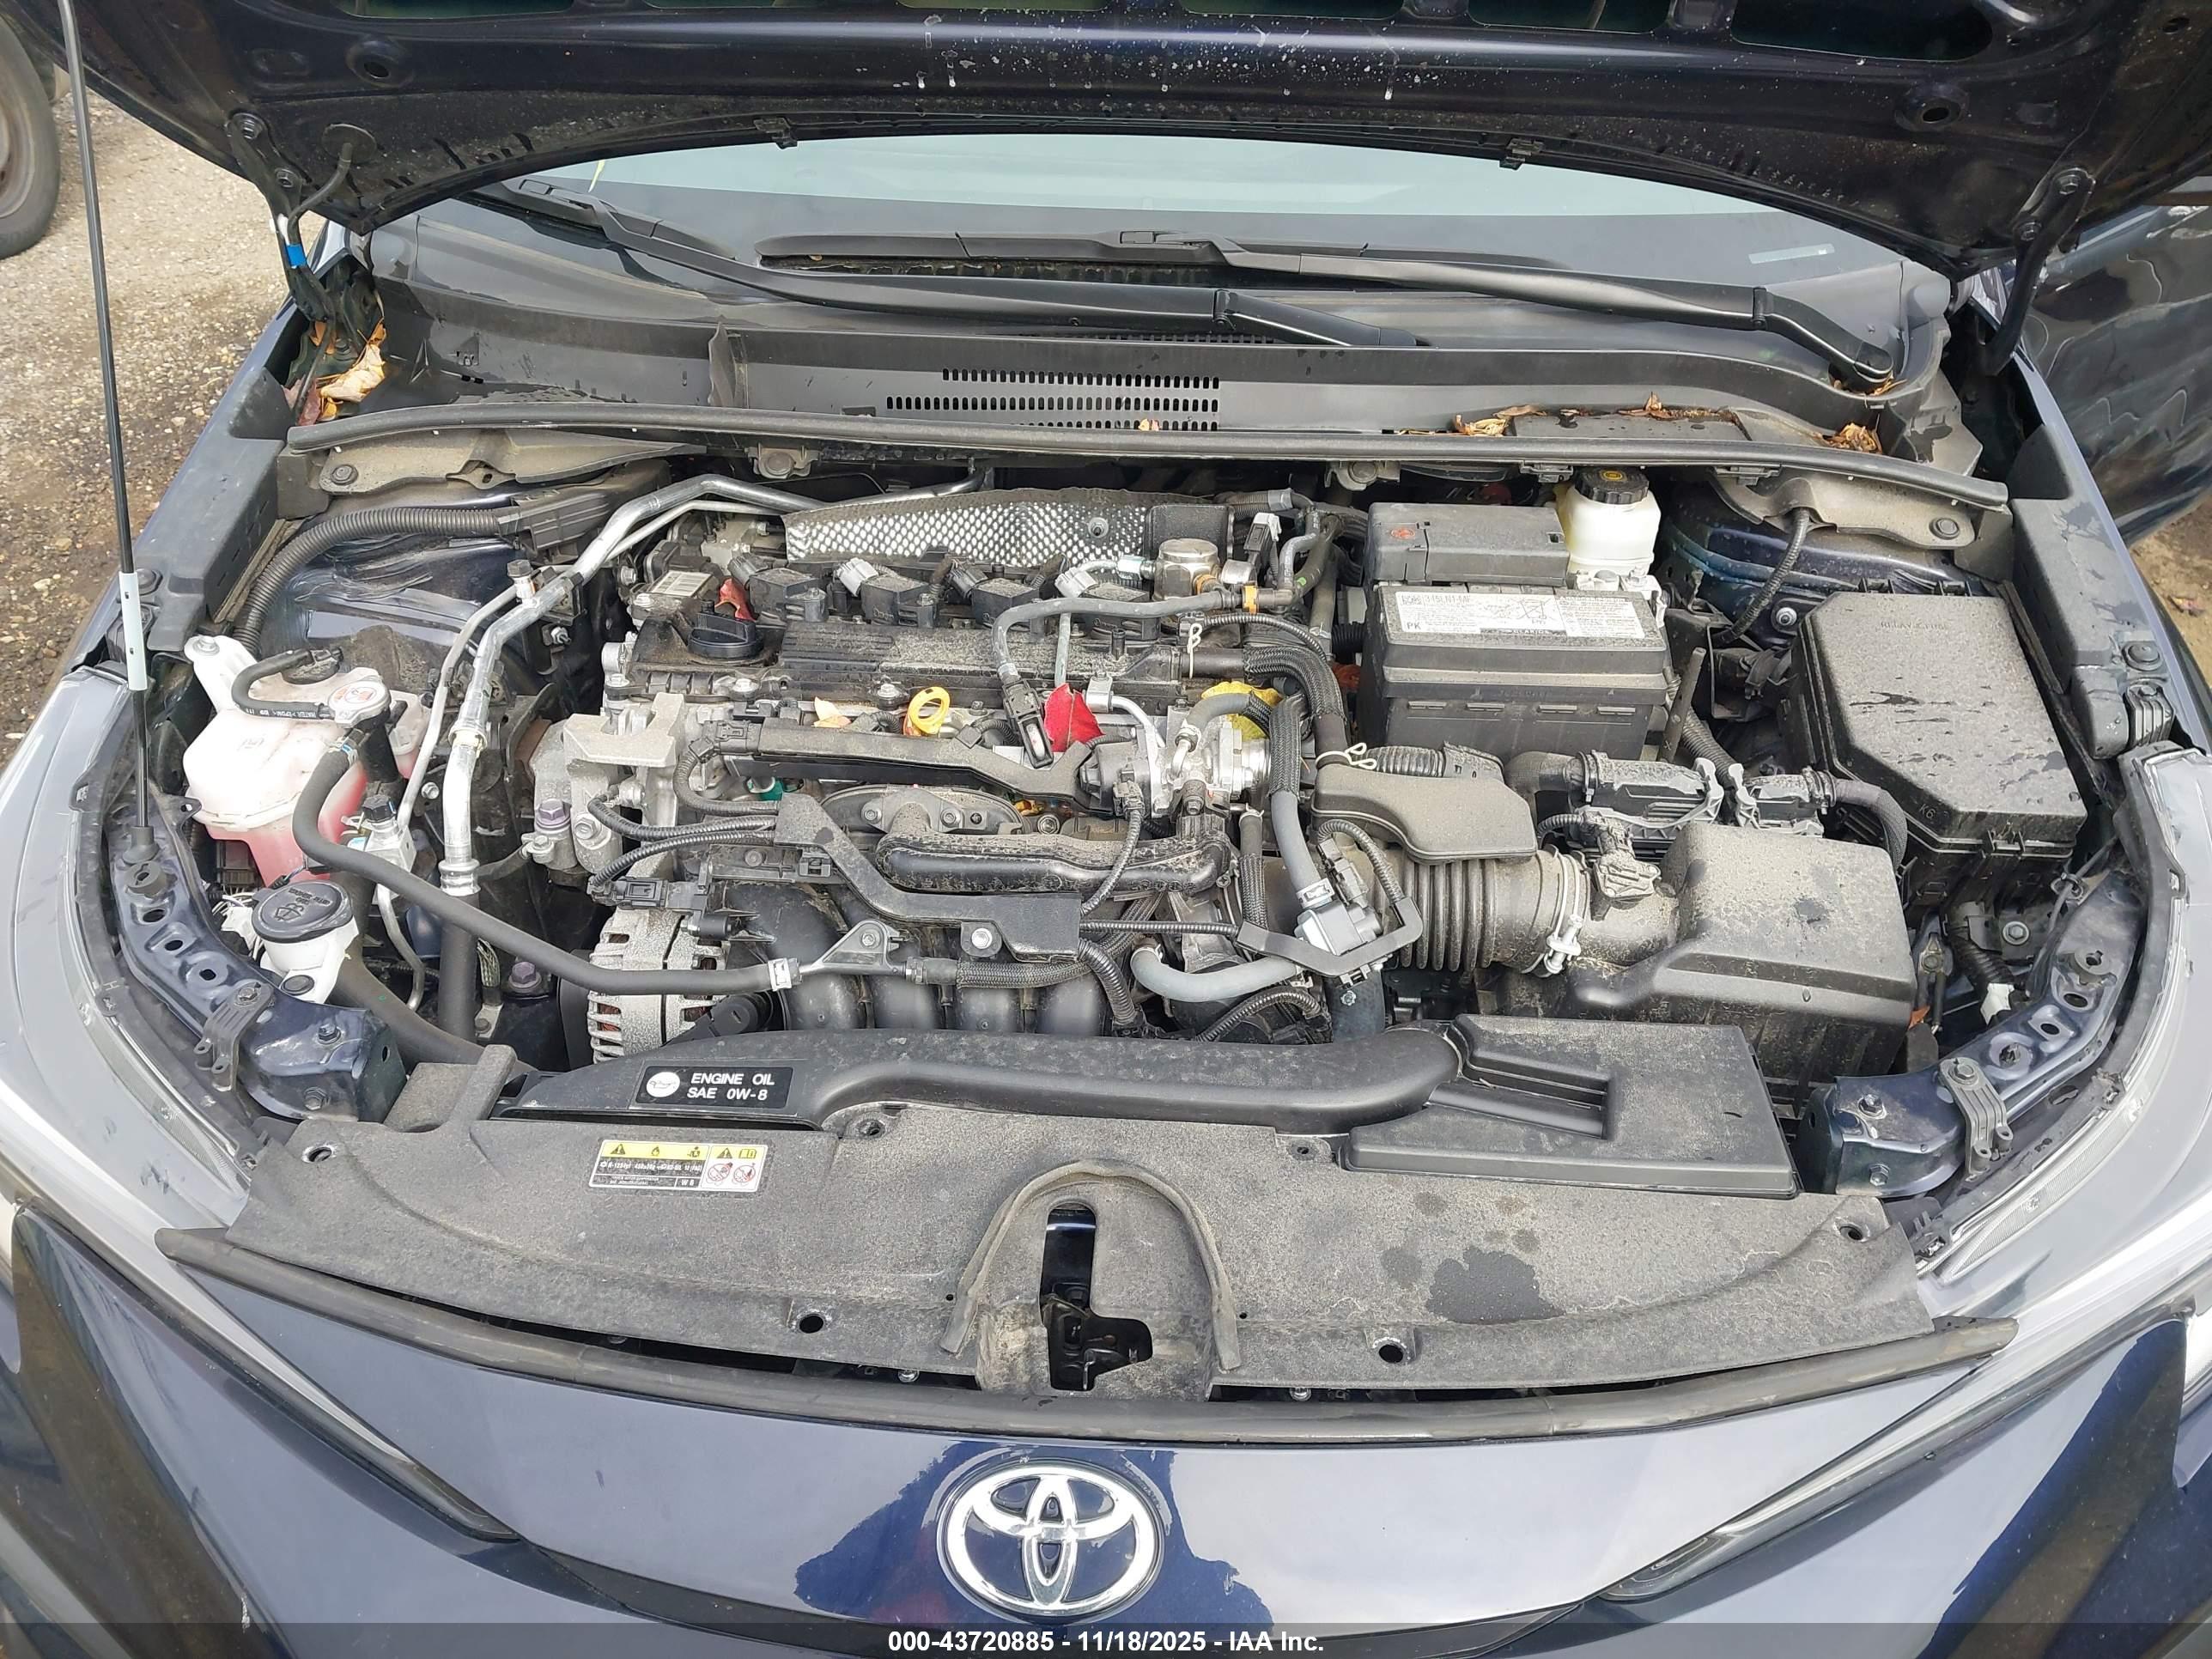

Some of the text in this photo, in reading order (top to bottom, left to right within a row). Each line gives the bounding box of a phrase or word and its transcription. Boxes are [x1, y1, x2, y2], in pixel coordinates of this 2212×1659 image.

[1407, 621, 1421, 630] PK
[690, 1073, 775, 1086] ENGINE OIL
[686, 1086, 769, 1101] SAE 0W-8
